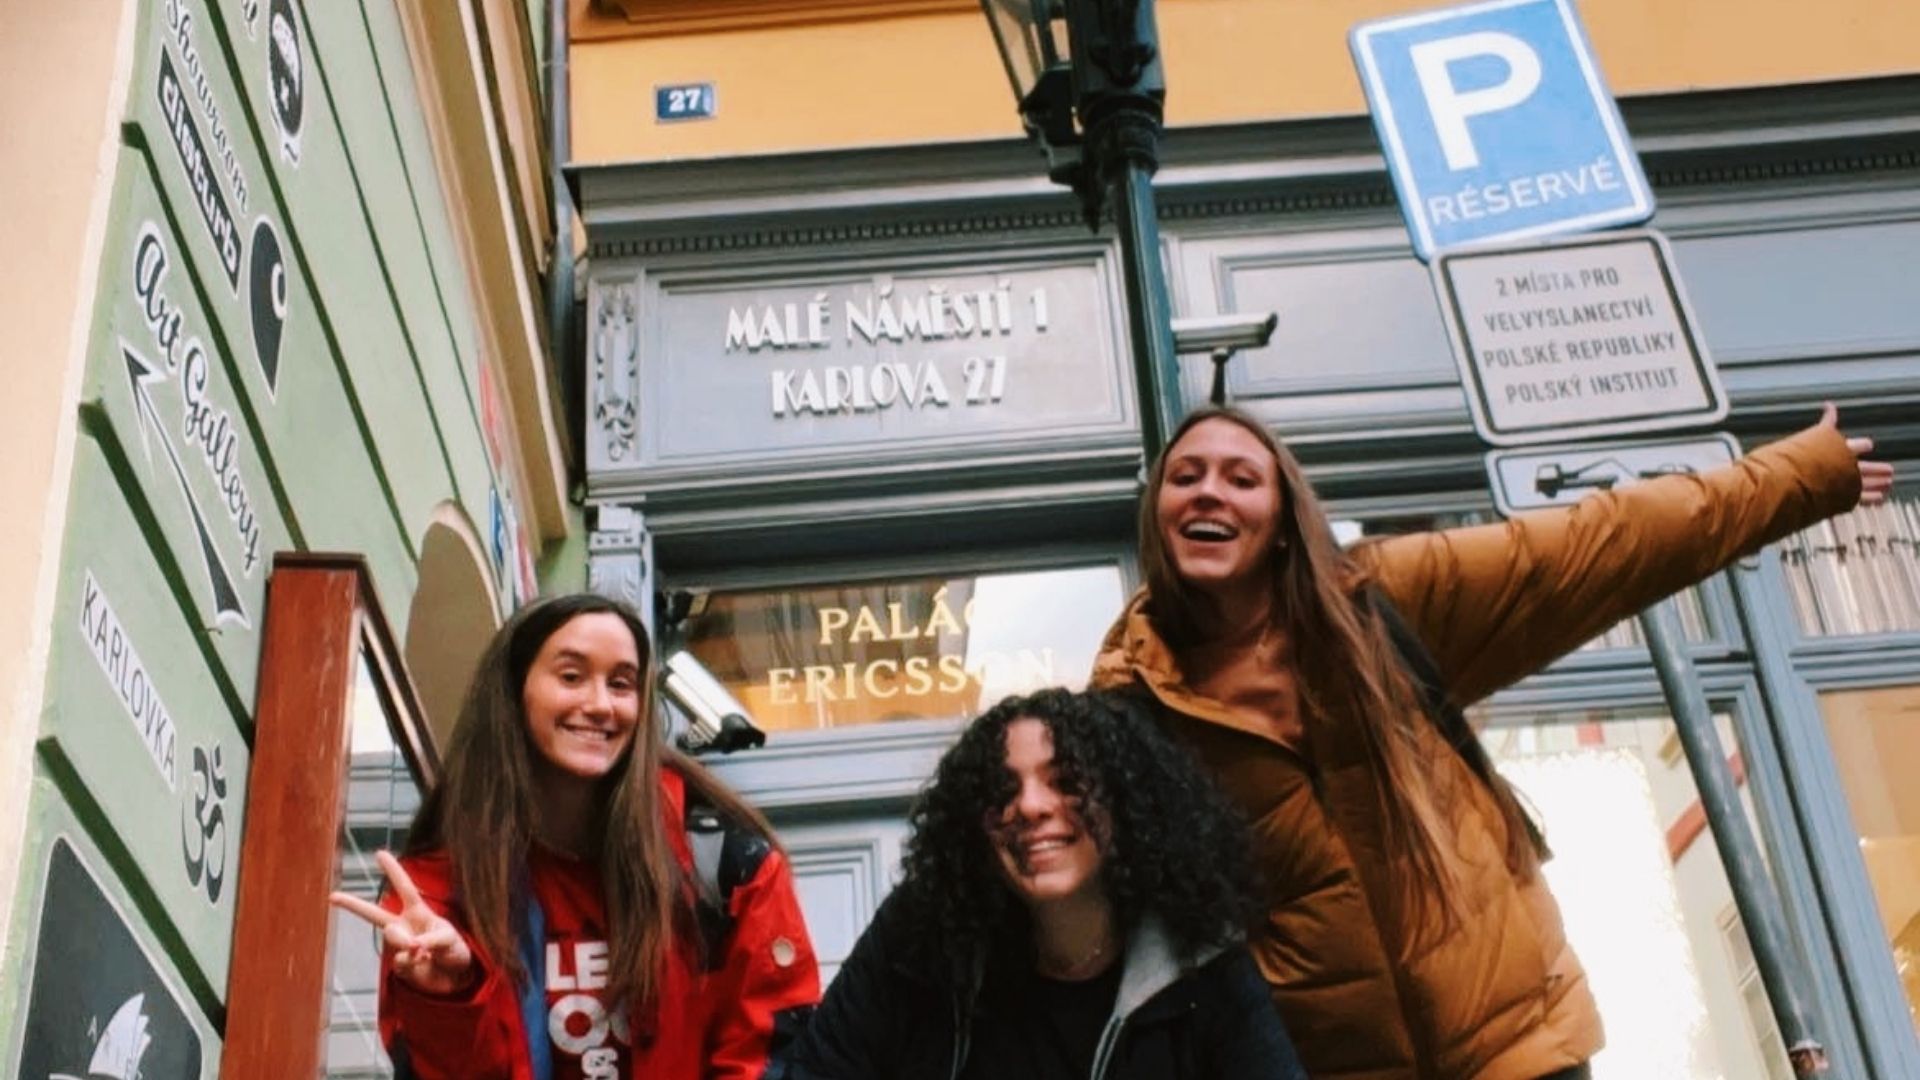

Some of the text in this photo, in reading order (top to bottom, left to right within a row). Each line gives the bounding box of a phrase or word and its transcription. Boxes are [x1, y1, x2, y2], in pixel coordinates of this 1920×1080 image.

[669, 88, 701, 112] 27
[1409, 30, 1542, 172] P
[162, 75, 238, 274] disturb
[1426, 154, 1622, 226] RÉSERVÉ
[1495, 266, 1620, 297] 2 MÍSTA PRO
[725, 278, 1048, 351] MALÉ NÁMĚSTÍ 1
[1483, 294, 1655, 333] VELVYSLANECTVÍ
[1482, 331, 1677, 370] POLSKÉ REPUBLIKY
[135, 233, 259, 571] Art Gallery
[771, 355, 1006, 418] KARLOVA 27
[1504, 366, 1680, 405] POLSKÝ INSTITUT
[818, 585, 976, 645] PALÁ
[81, 578, 175, 785] KARLOVKA
